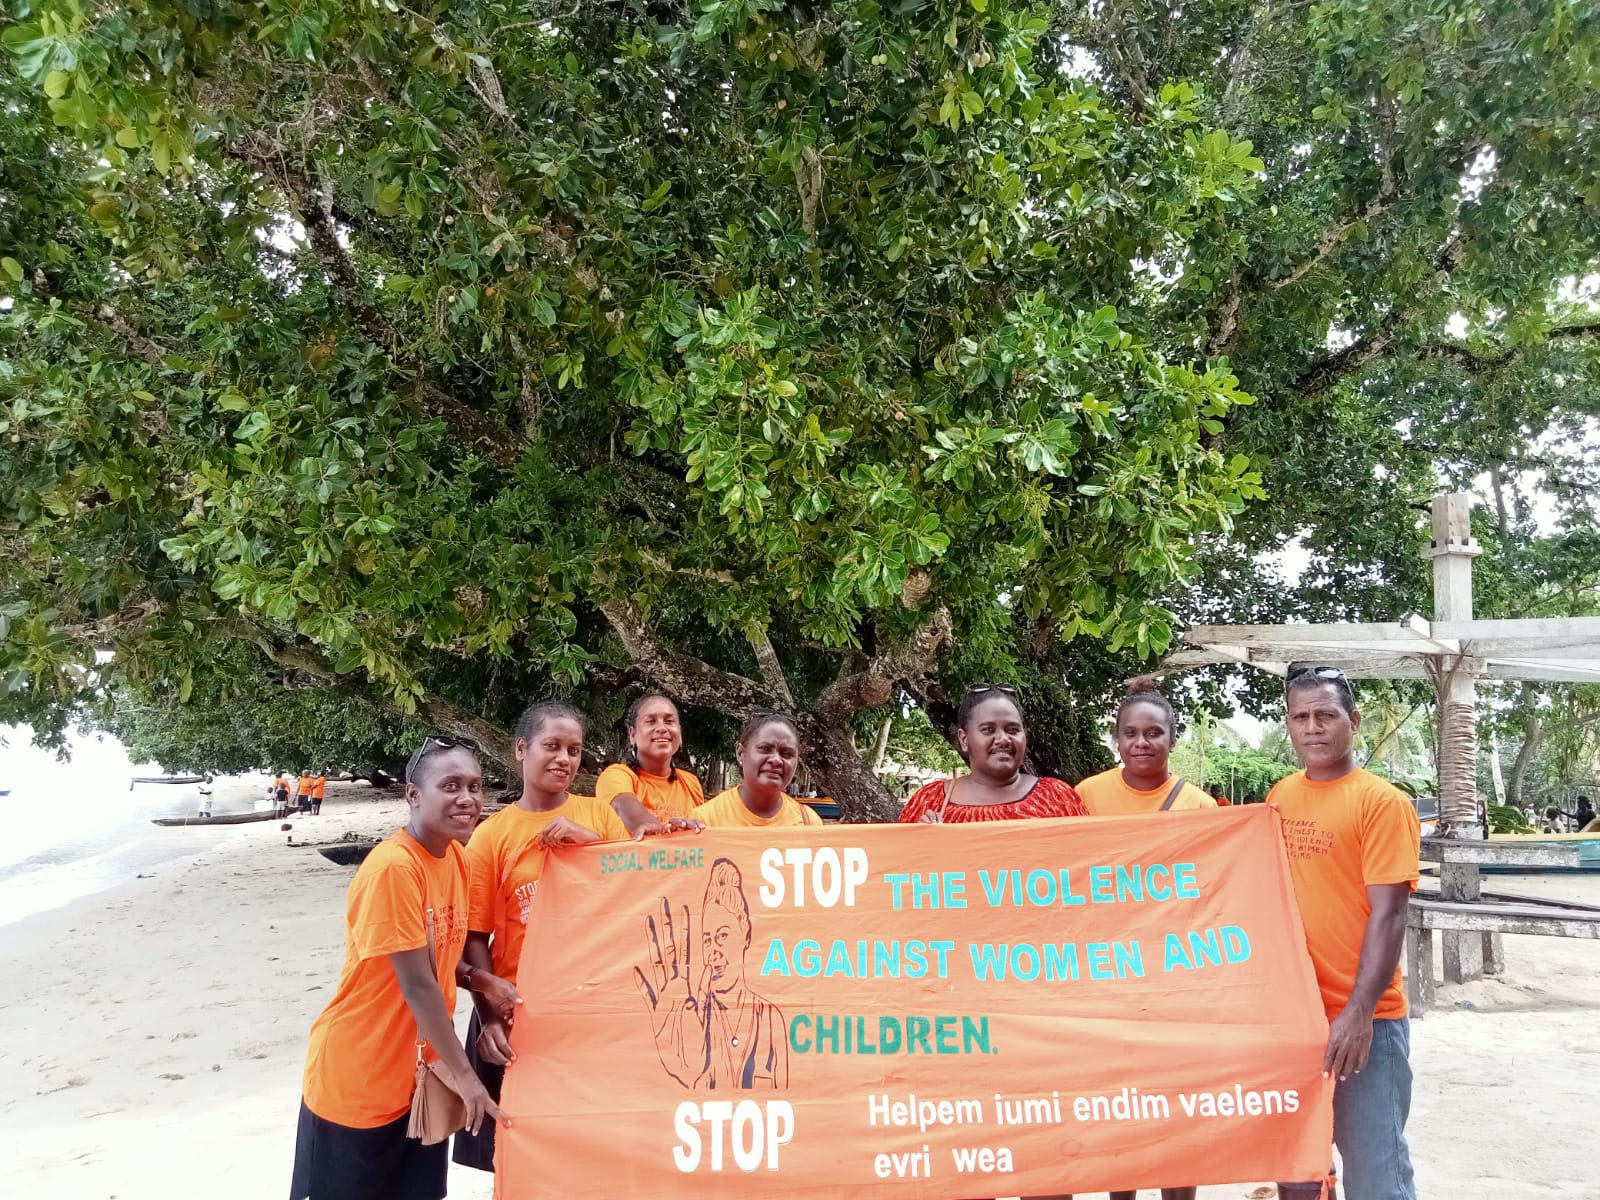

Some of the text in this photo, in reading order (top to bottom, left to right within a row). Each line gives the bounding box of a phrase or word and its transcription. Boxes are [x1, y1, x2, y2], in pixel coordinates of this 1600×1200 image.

[1321, 830, 1334, 839] TO
[600, 847, 704, 875] SOCIAL WELFARE
[759, 847, 1200, 910] STOP THE VIOLENCE
[759, 925, 1252, 982] AGAINST WOMEN AND
[789, 1014, 998, 1055] CHILDREN.
[868, 1083, 1300, 1133] Helpem iumi endim vaelens
[672, 1100, 794, 1173] STOP
[874, 1144, 1013, 1178] evri wea
